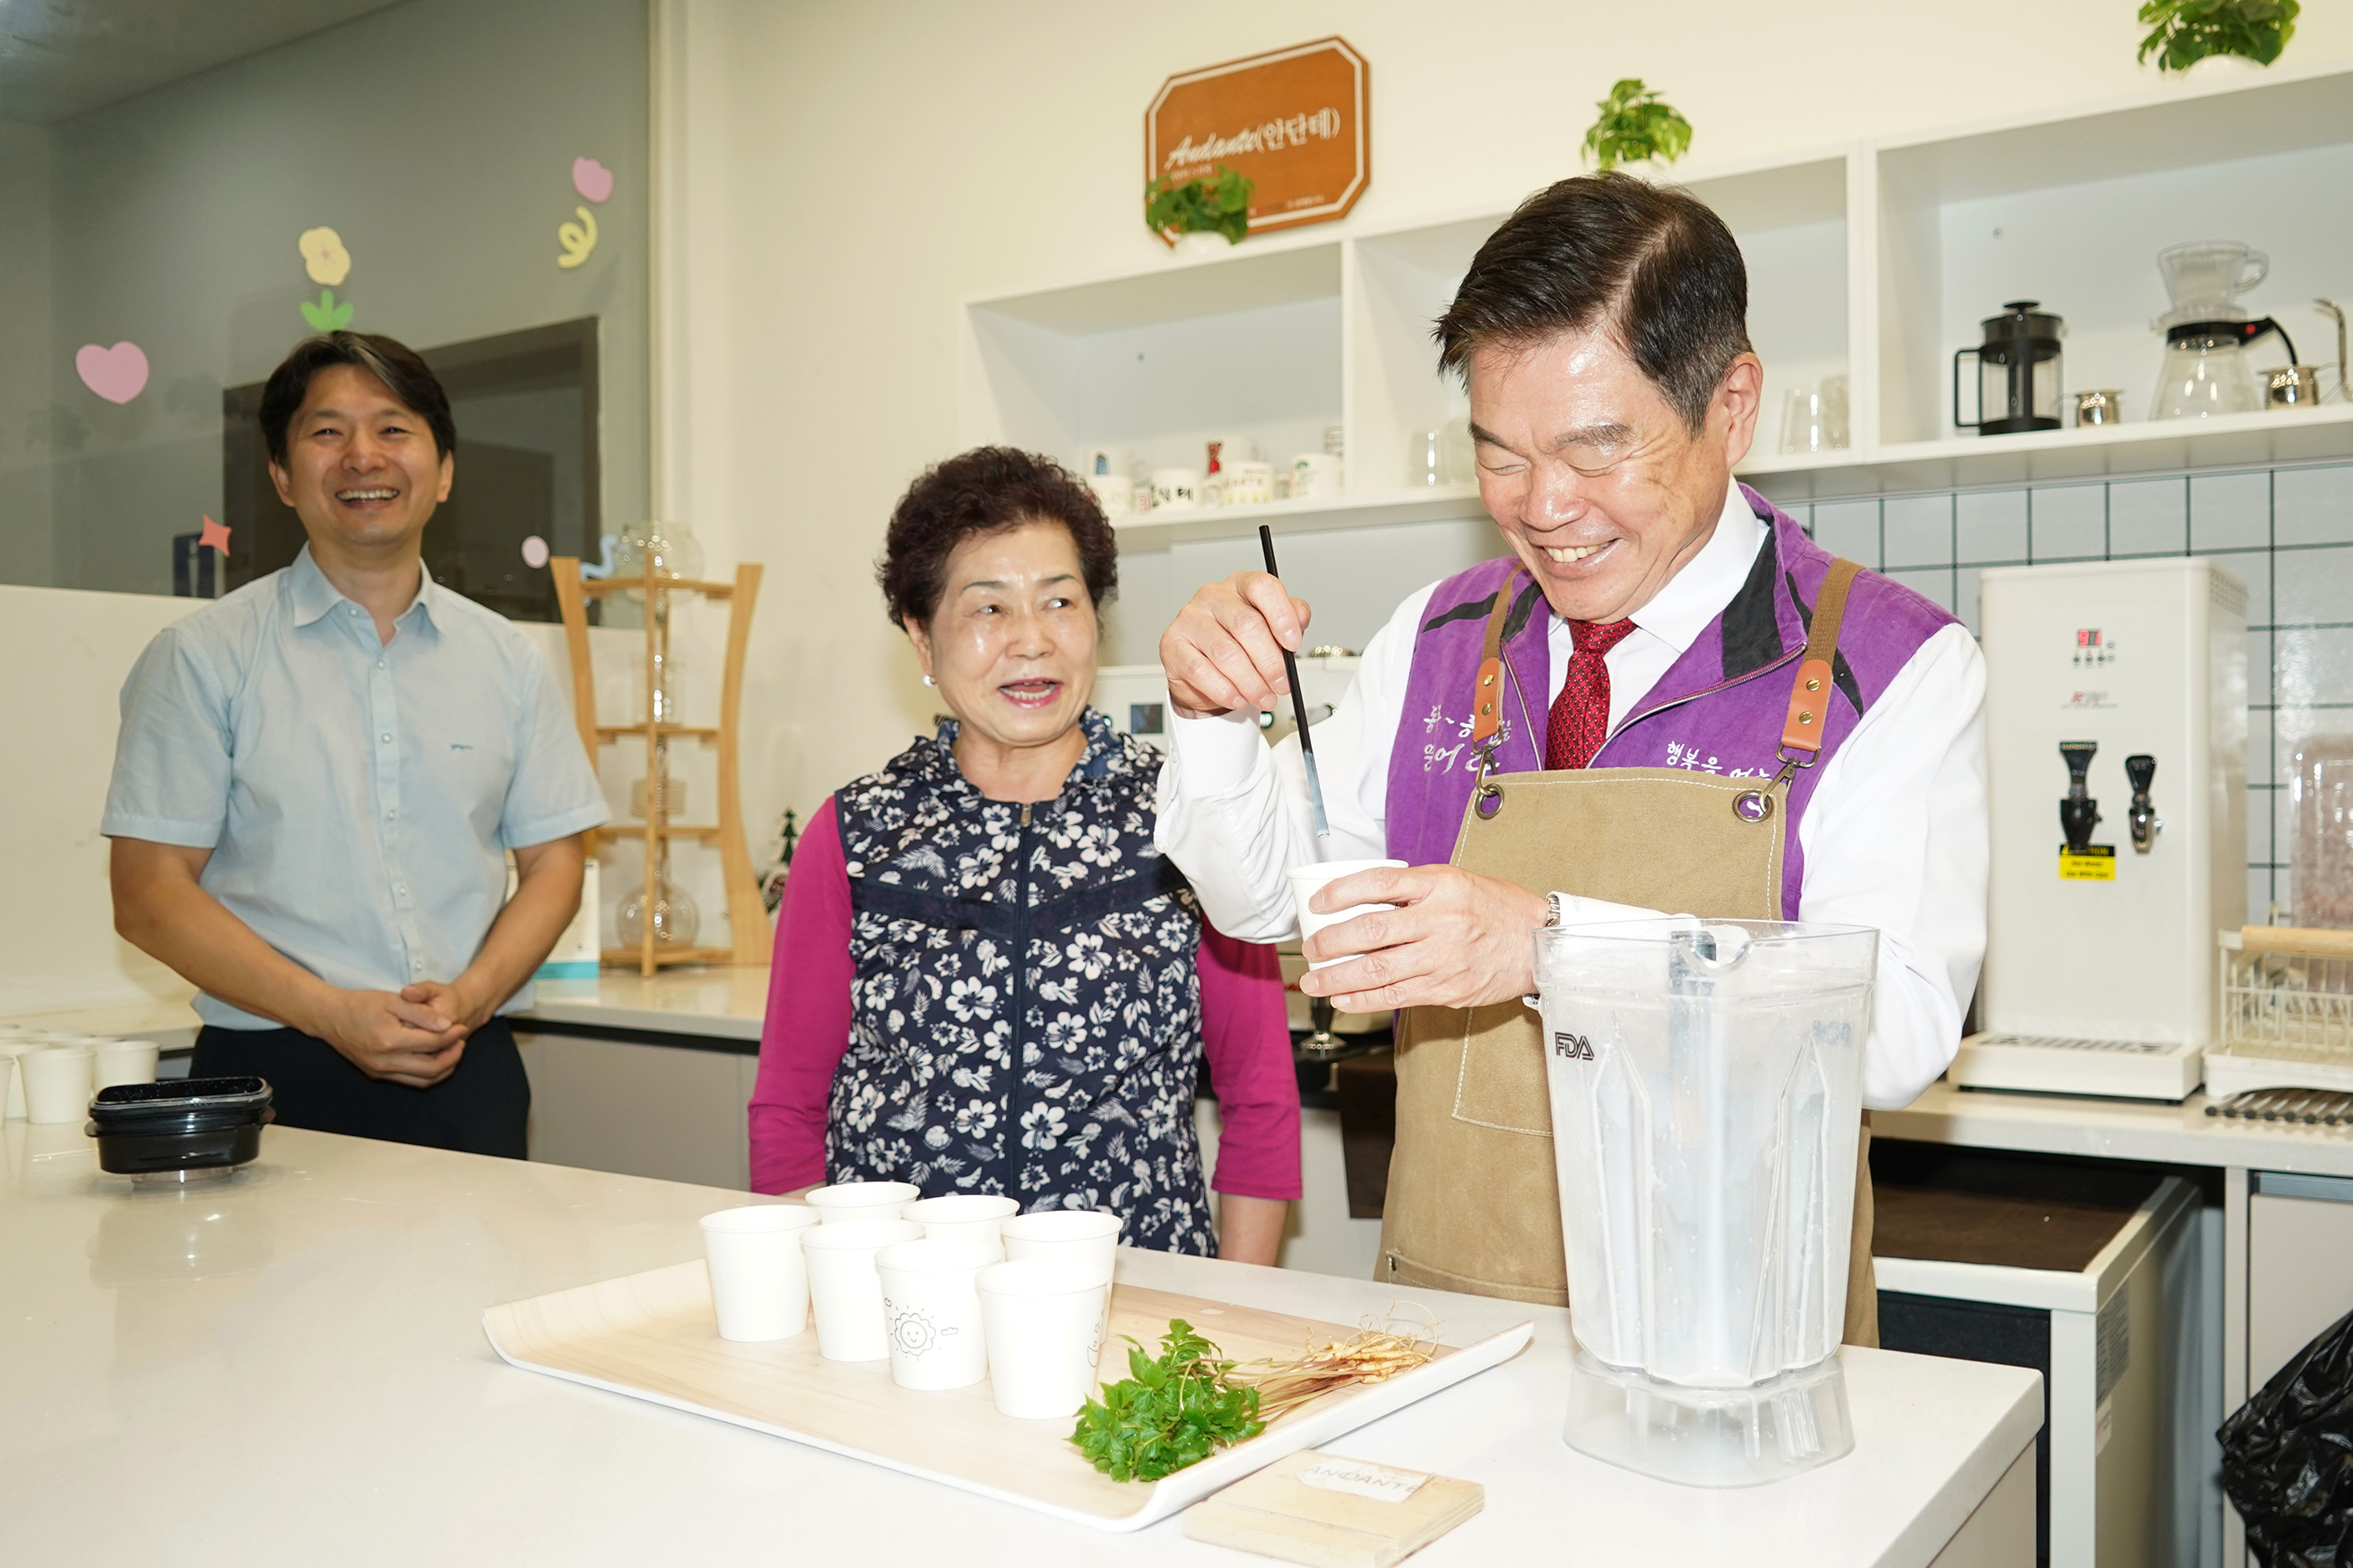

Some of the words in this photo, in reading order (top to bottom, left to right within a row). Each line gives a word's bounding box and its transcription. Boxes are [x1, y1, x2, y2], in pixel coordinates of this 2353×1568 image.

[2078, 630, 2102, 646] 91
[1555, 1032, 1594, 1061] FDA
[1304, 1466, 1419, 1493] ANDANTE
